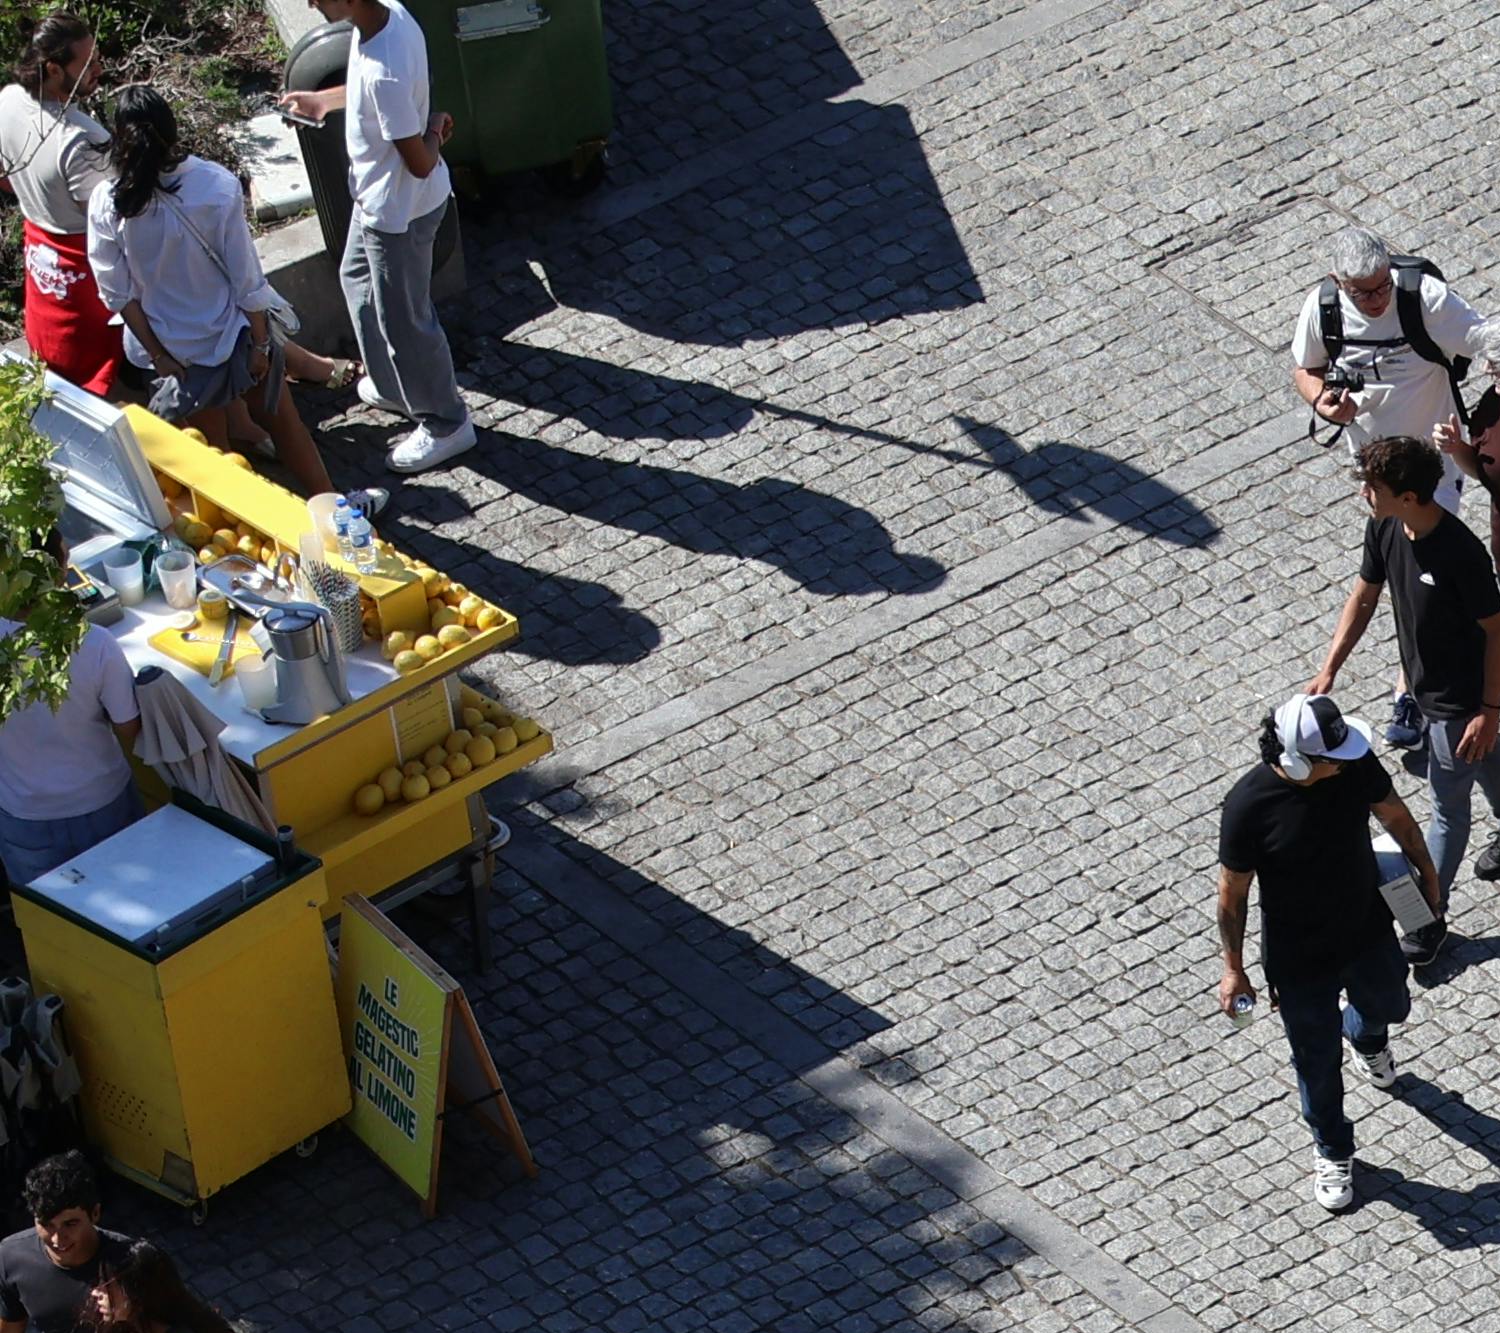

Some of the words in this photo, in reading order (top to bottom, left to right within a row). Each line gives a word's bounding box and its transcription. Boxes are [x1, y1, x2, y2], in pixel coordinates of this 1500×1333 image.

[357, 983, 420, 1059] MAGESTIC
[384, 976, 398, 1007] LE
[350, 1055, 365, 1092] AL
[367, 1072, 417, 1141] LIMONE
[355, 1021, 416, 1099] GELATINO
